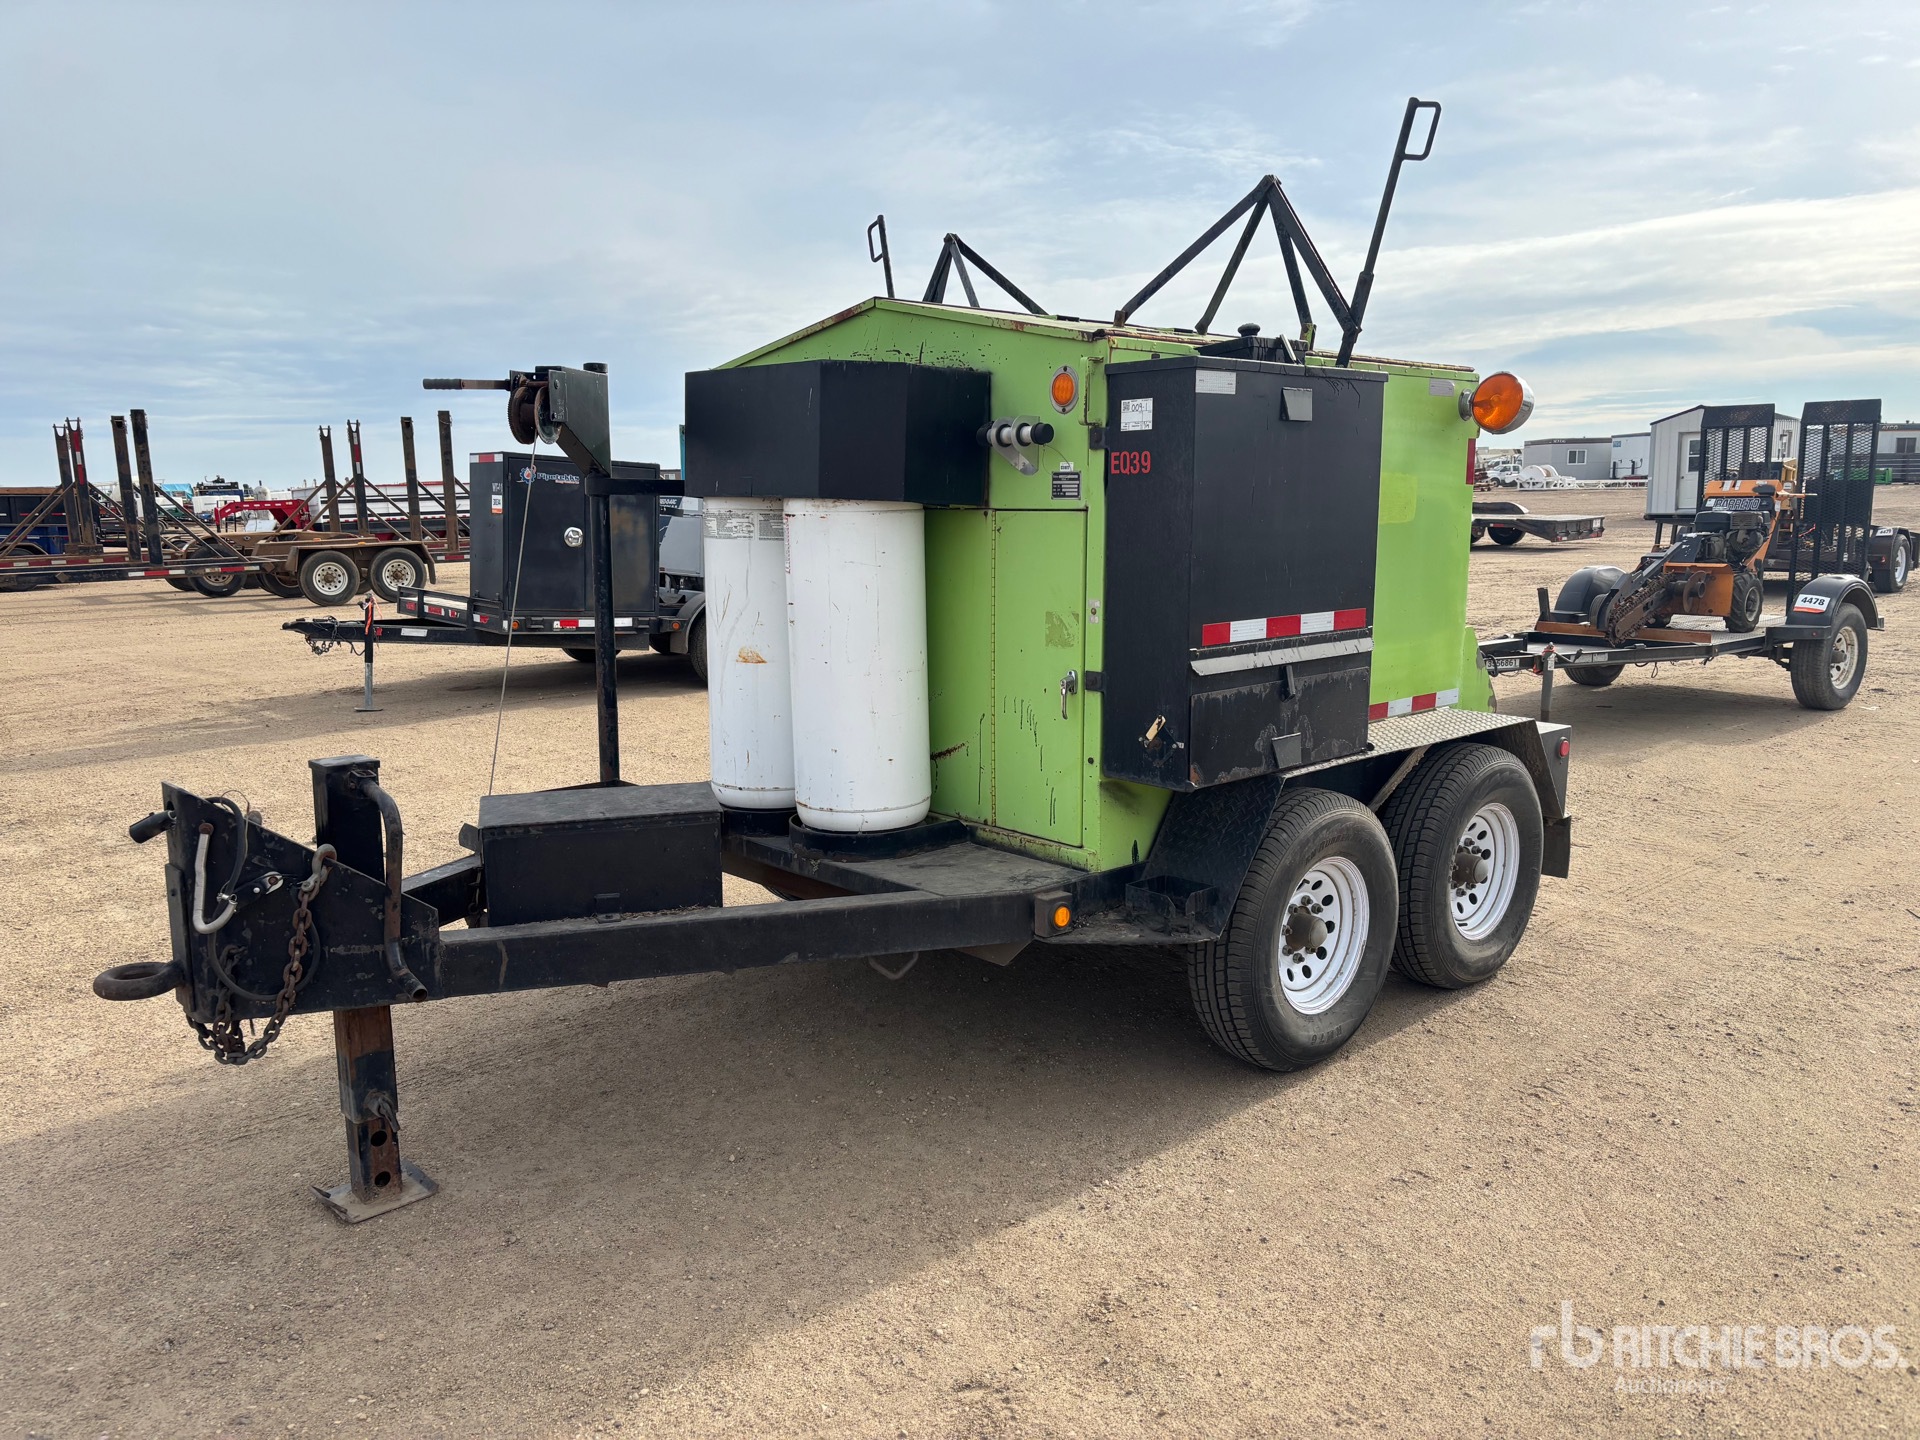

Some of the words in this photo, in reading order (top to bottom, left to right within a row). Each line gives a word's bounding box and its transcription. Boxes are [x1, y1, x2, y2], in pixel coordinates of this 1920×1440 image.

[1111, 451, 1151, 475] EQ39
[1715, 497, 1761, 511] BARRETO
[1801, 596, 1825, 606] 4478
